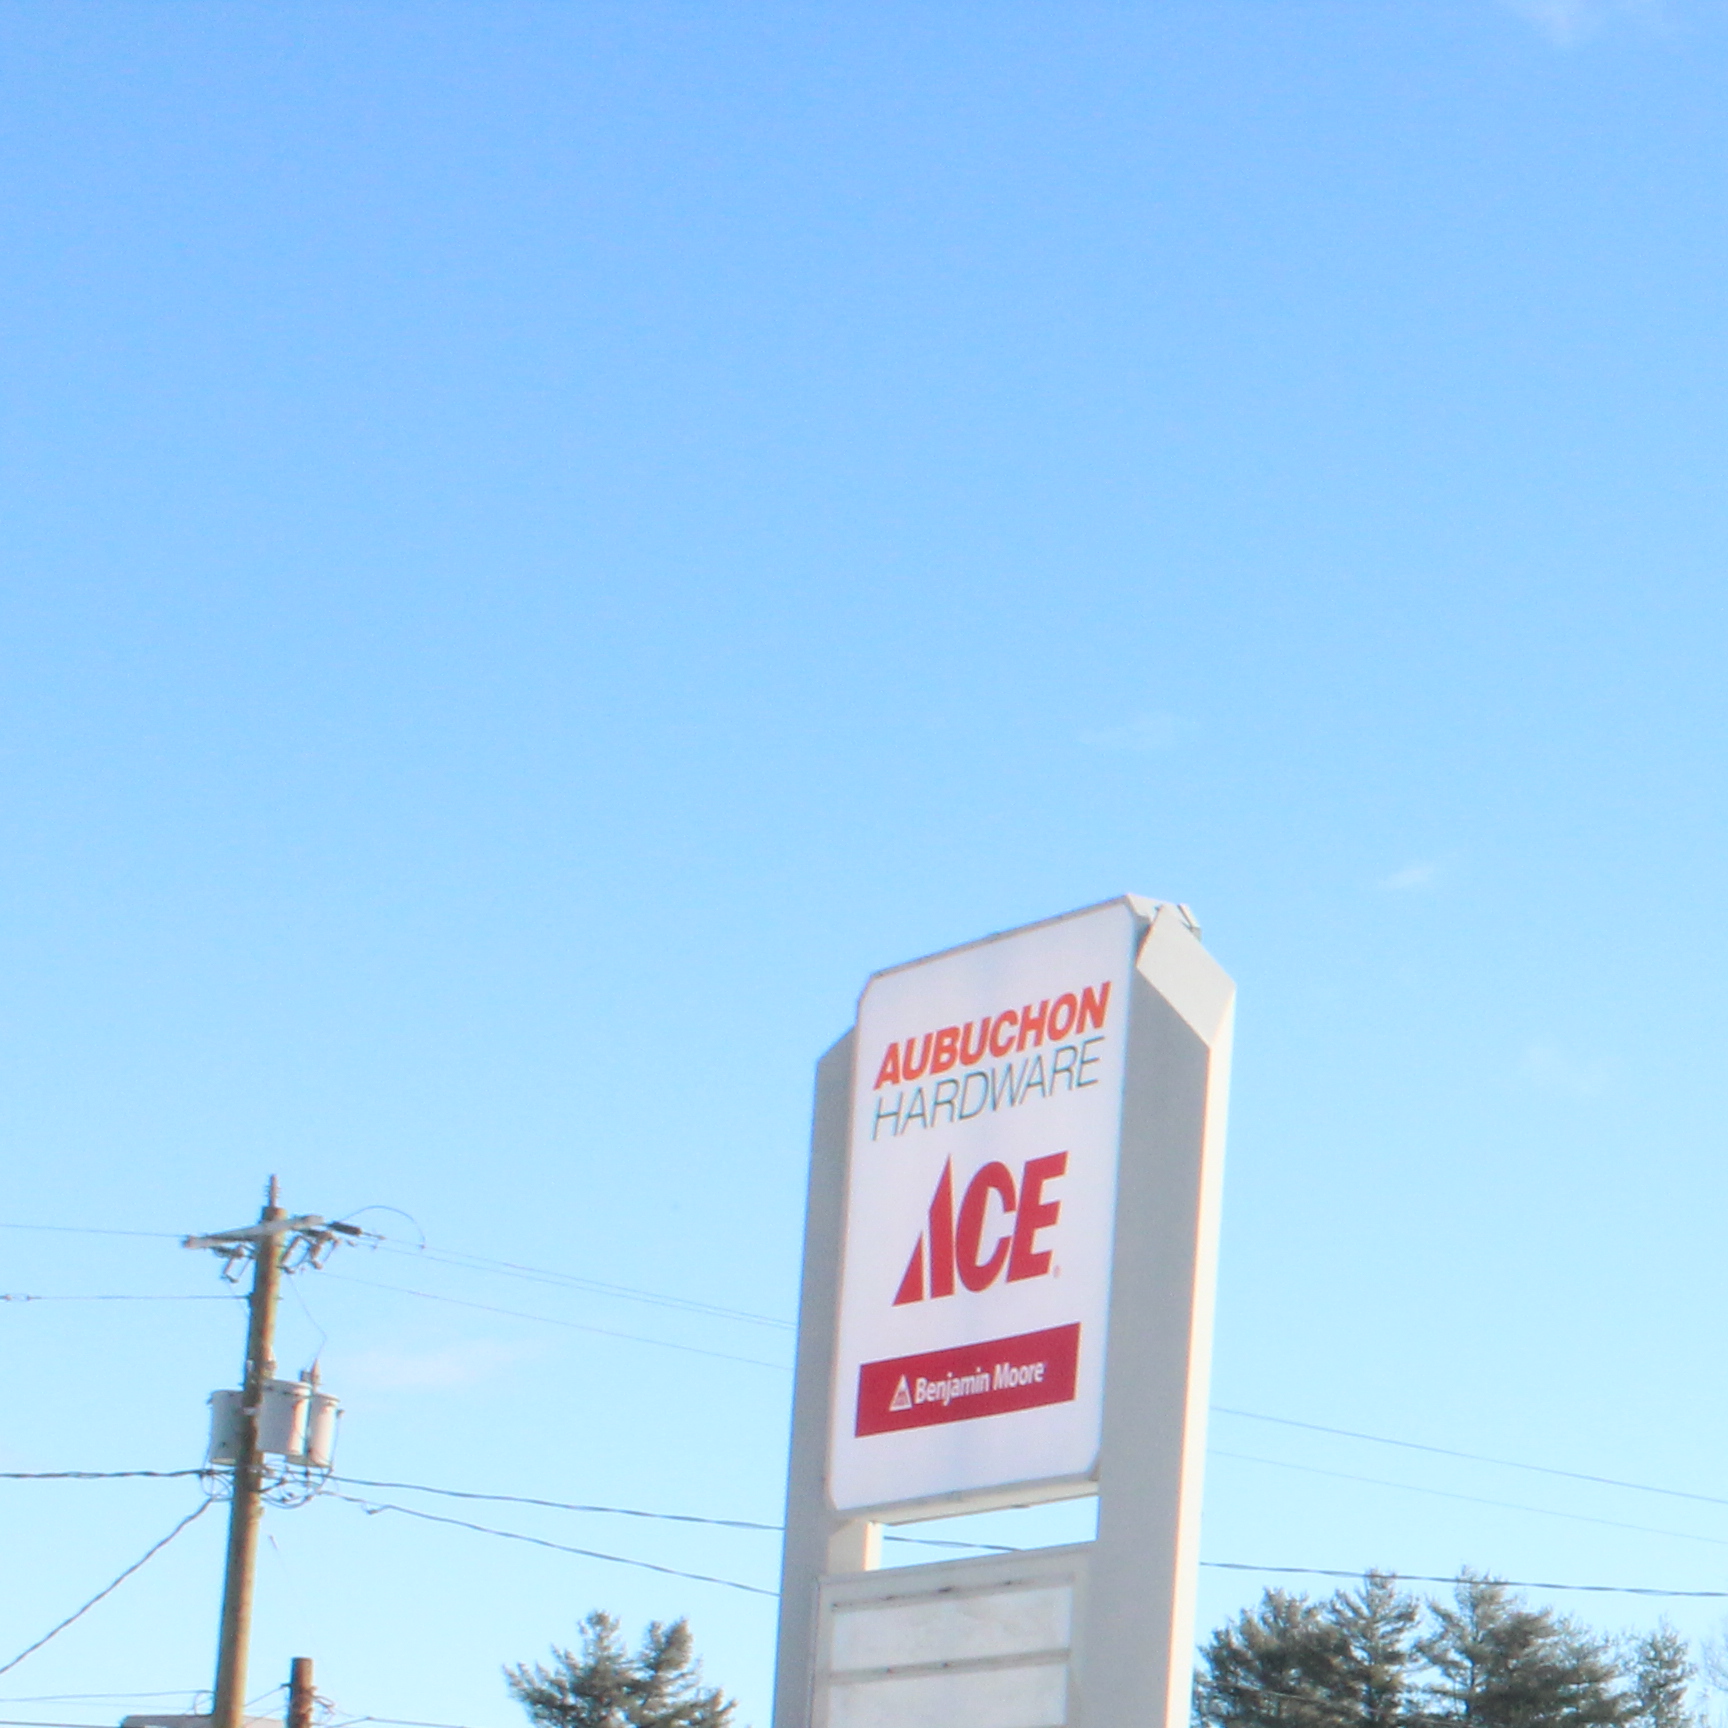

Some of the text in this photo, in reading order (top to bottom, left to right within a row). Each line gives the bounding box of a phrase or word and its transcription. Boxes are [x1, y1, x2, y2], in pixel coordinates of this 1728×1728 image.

[872, 1036, 1105, 1141] HARDWARE
[873, 980, 1112, 1091] AUBUCHON
[892, 1151, 1069, 1306] ACE
[914, 1362, 1045, 1406] Benjamin Moore
